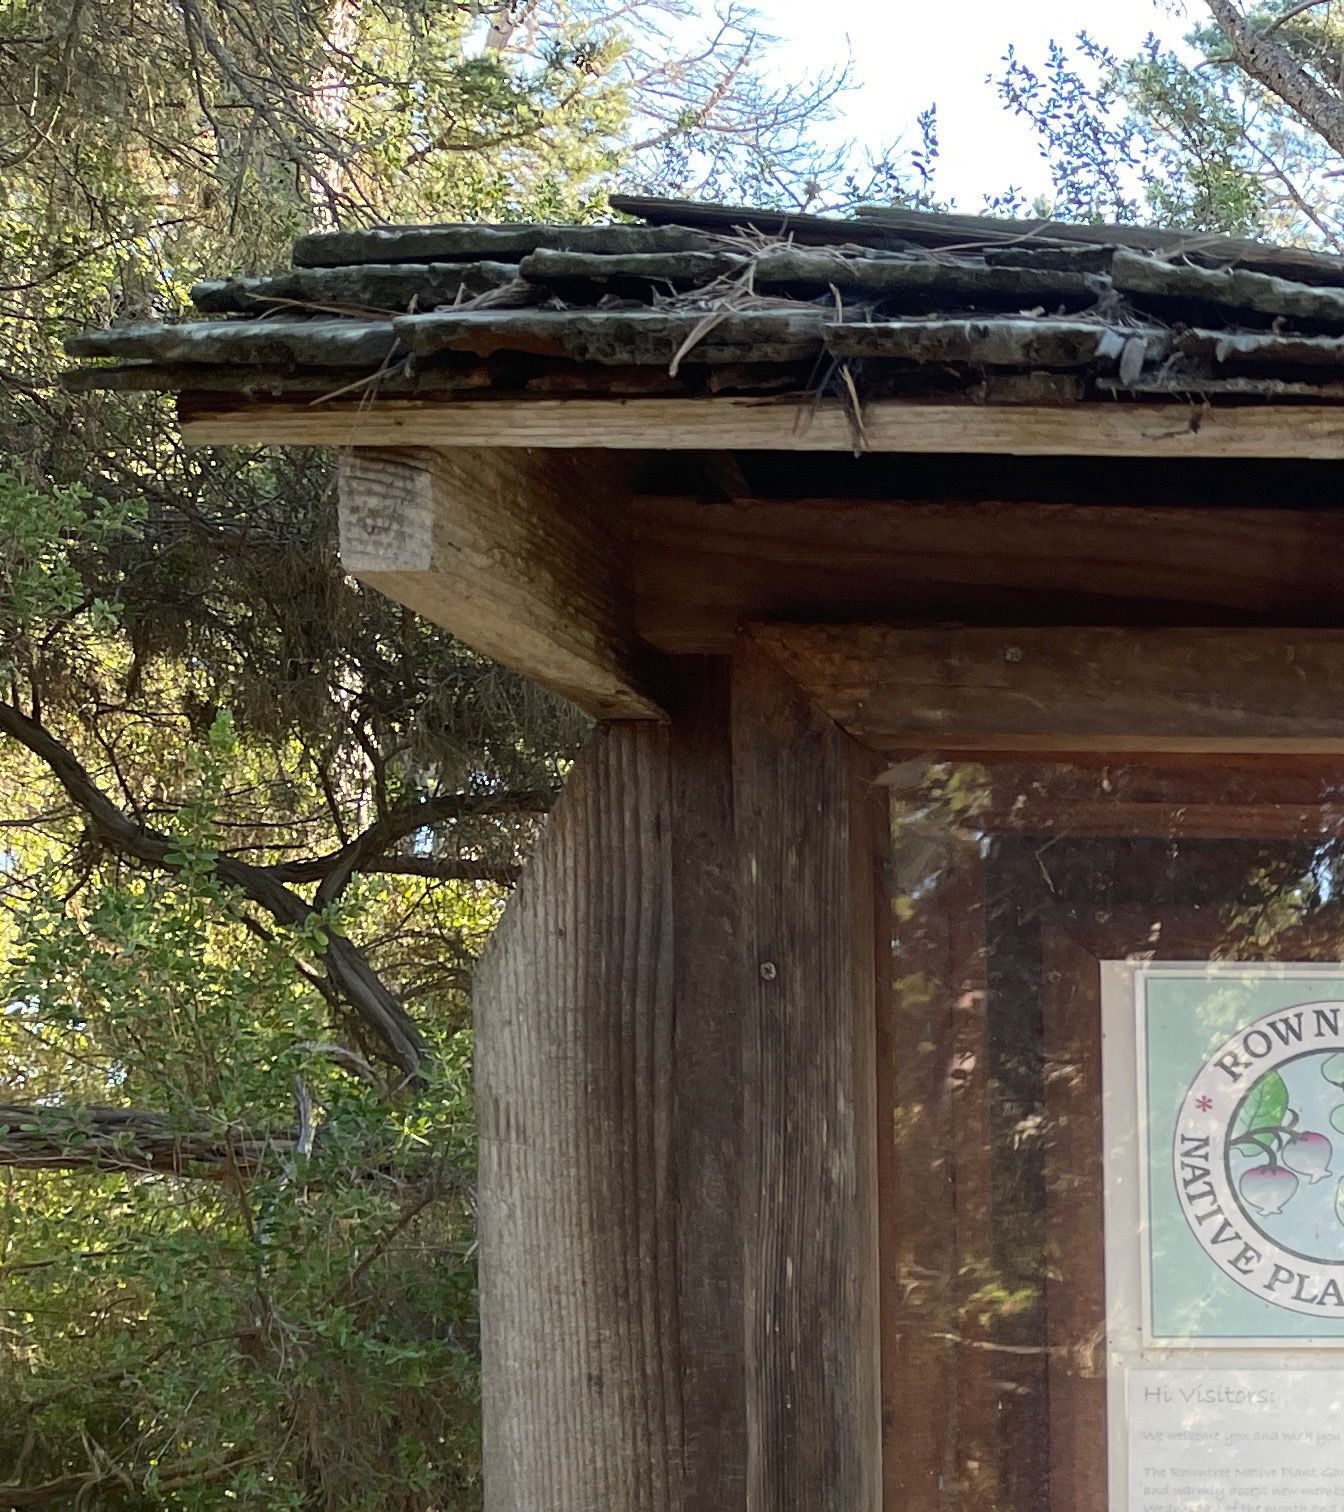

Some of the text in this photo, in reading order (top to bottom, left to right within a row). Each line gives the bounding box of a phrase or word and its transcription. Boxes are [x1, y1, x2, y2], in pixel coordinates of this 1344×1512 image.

[1181, 1134, 1261, 1275] NATIVE
[1144, 1384, 1275, 1405] Hi Visitors:
